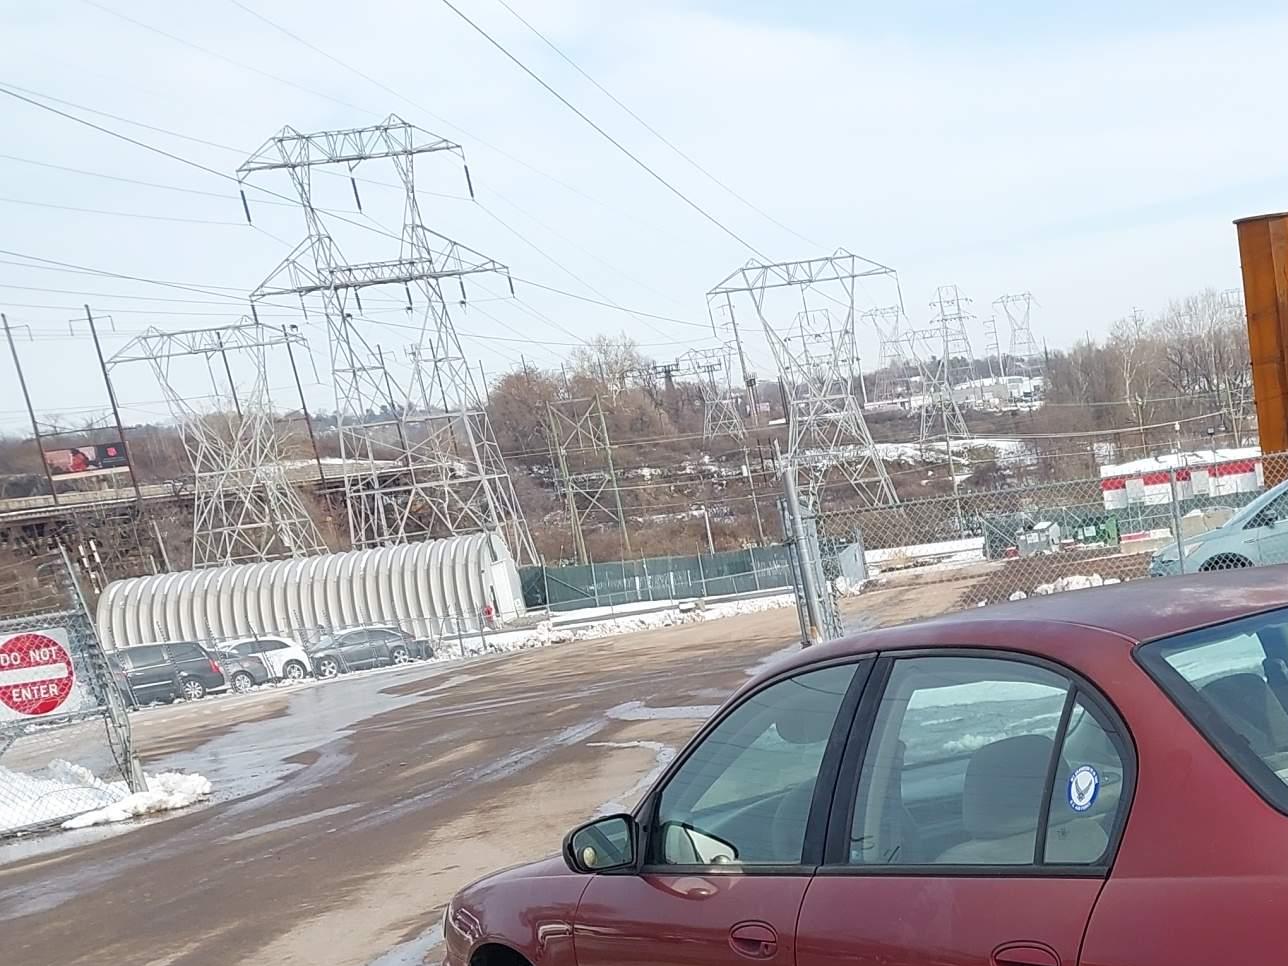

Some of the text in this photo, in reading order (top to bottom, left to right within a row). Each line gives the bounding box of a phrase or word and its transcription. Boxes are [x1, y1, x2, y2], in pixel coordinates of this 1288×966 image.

[0, 647, 58, 666] DO NOT
[12, 683, 59, 702] ENTER
